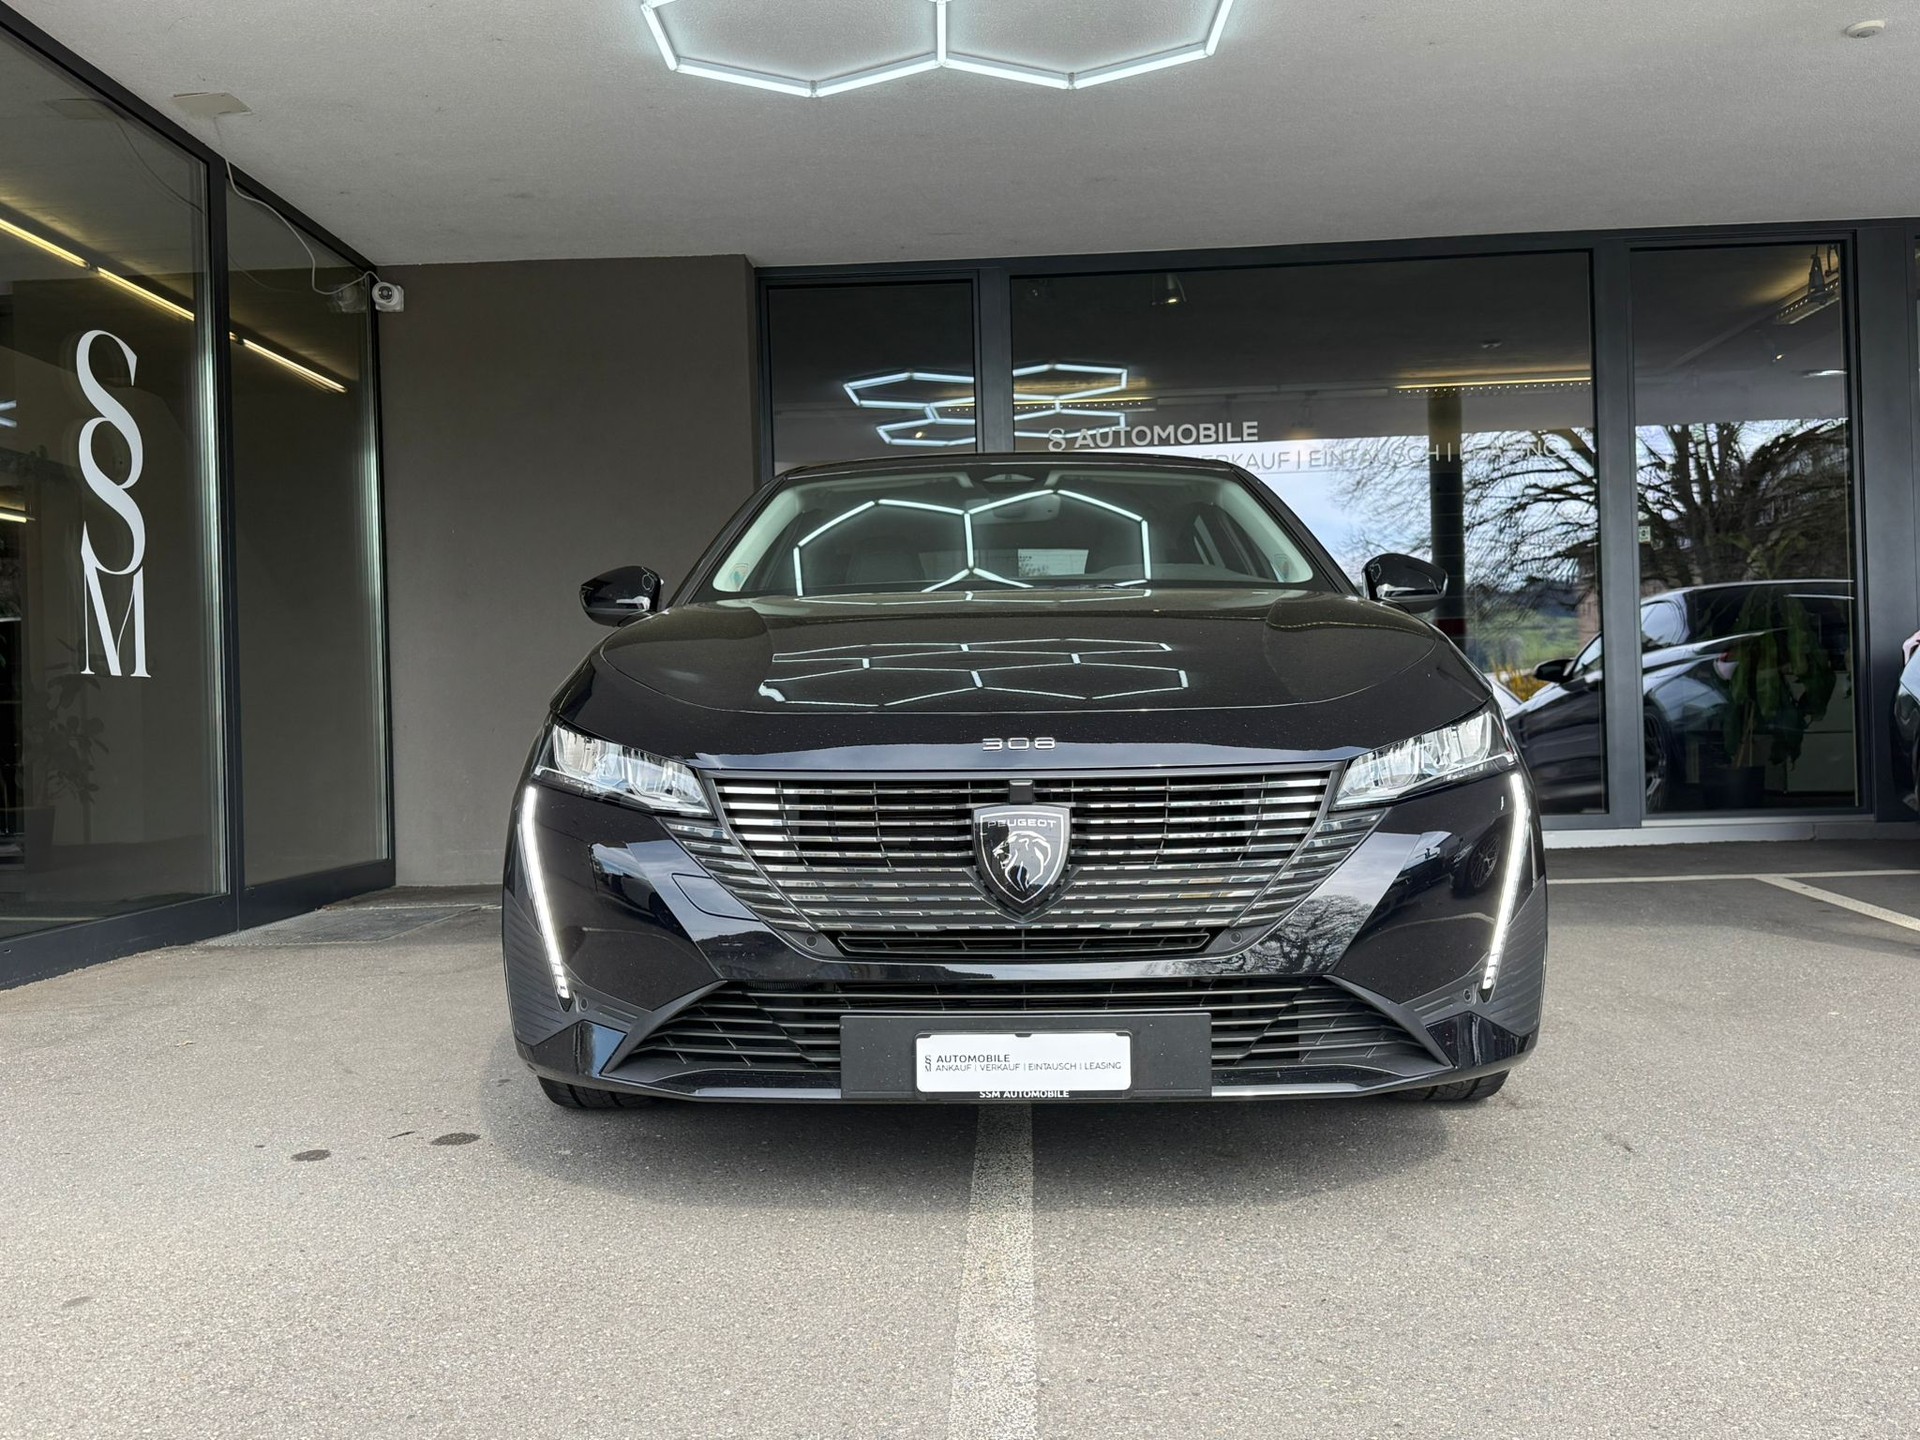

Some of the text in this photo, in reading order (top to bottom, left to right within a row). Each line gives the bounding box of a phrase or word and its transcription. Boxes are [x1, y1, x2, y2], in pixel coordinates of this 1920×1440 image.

[1073, 421, 1259, 449] AUTOMOBILE
[1309, 444, 1440, 468] EINTAUSCH
[982, 737, 1056, 751] 308
[987, 818, 1057, 828] PEUGEOT
[936, 1054, 1010, 1063] AUTOMOBILE
[935, 1061, 1122, 1072] ANKAUF VERKAUF EINTAUSCH LEASING
[979, 1090, 1070, 1098] SSM AUTOMOBILE
